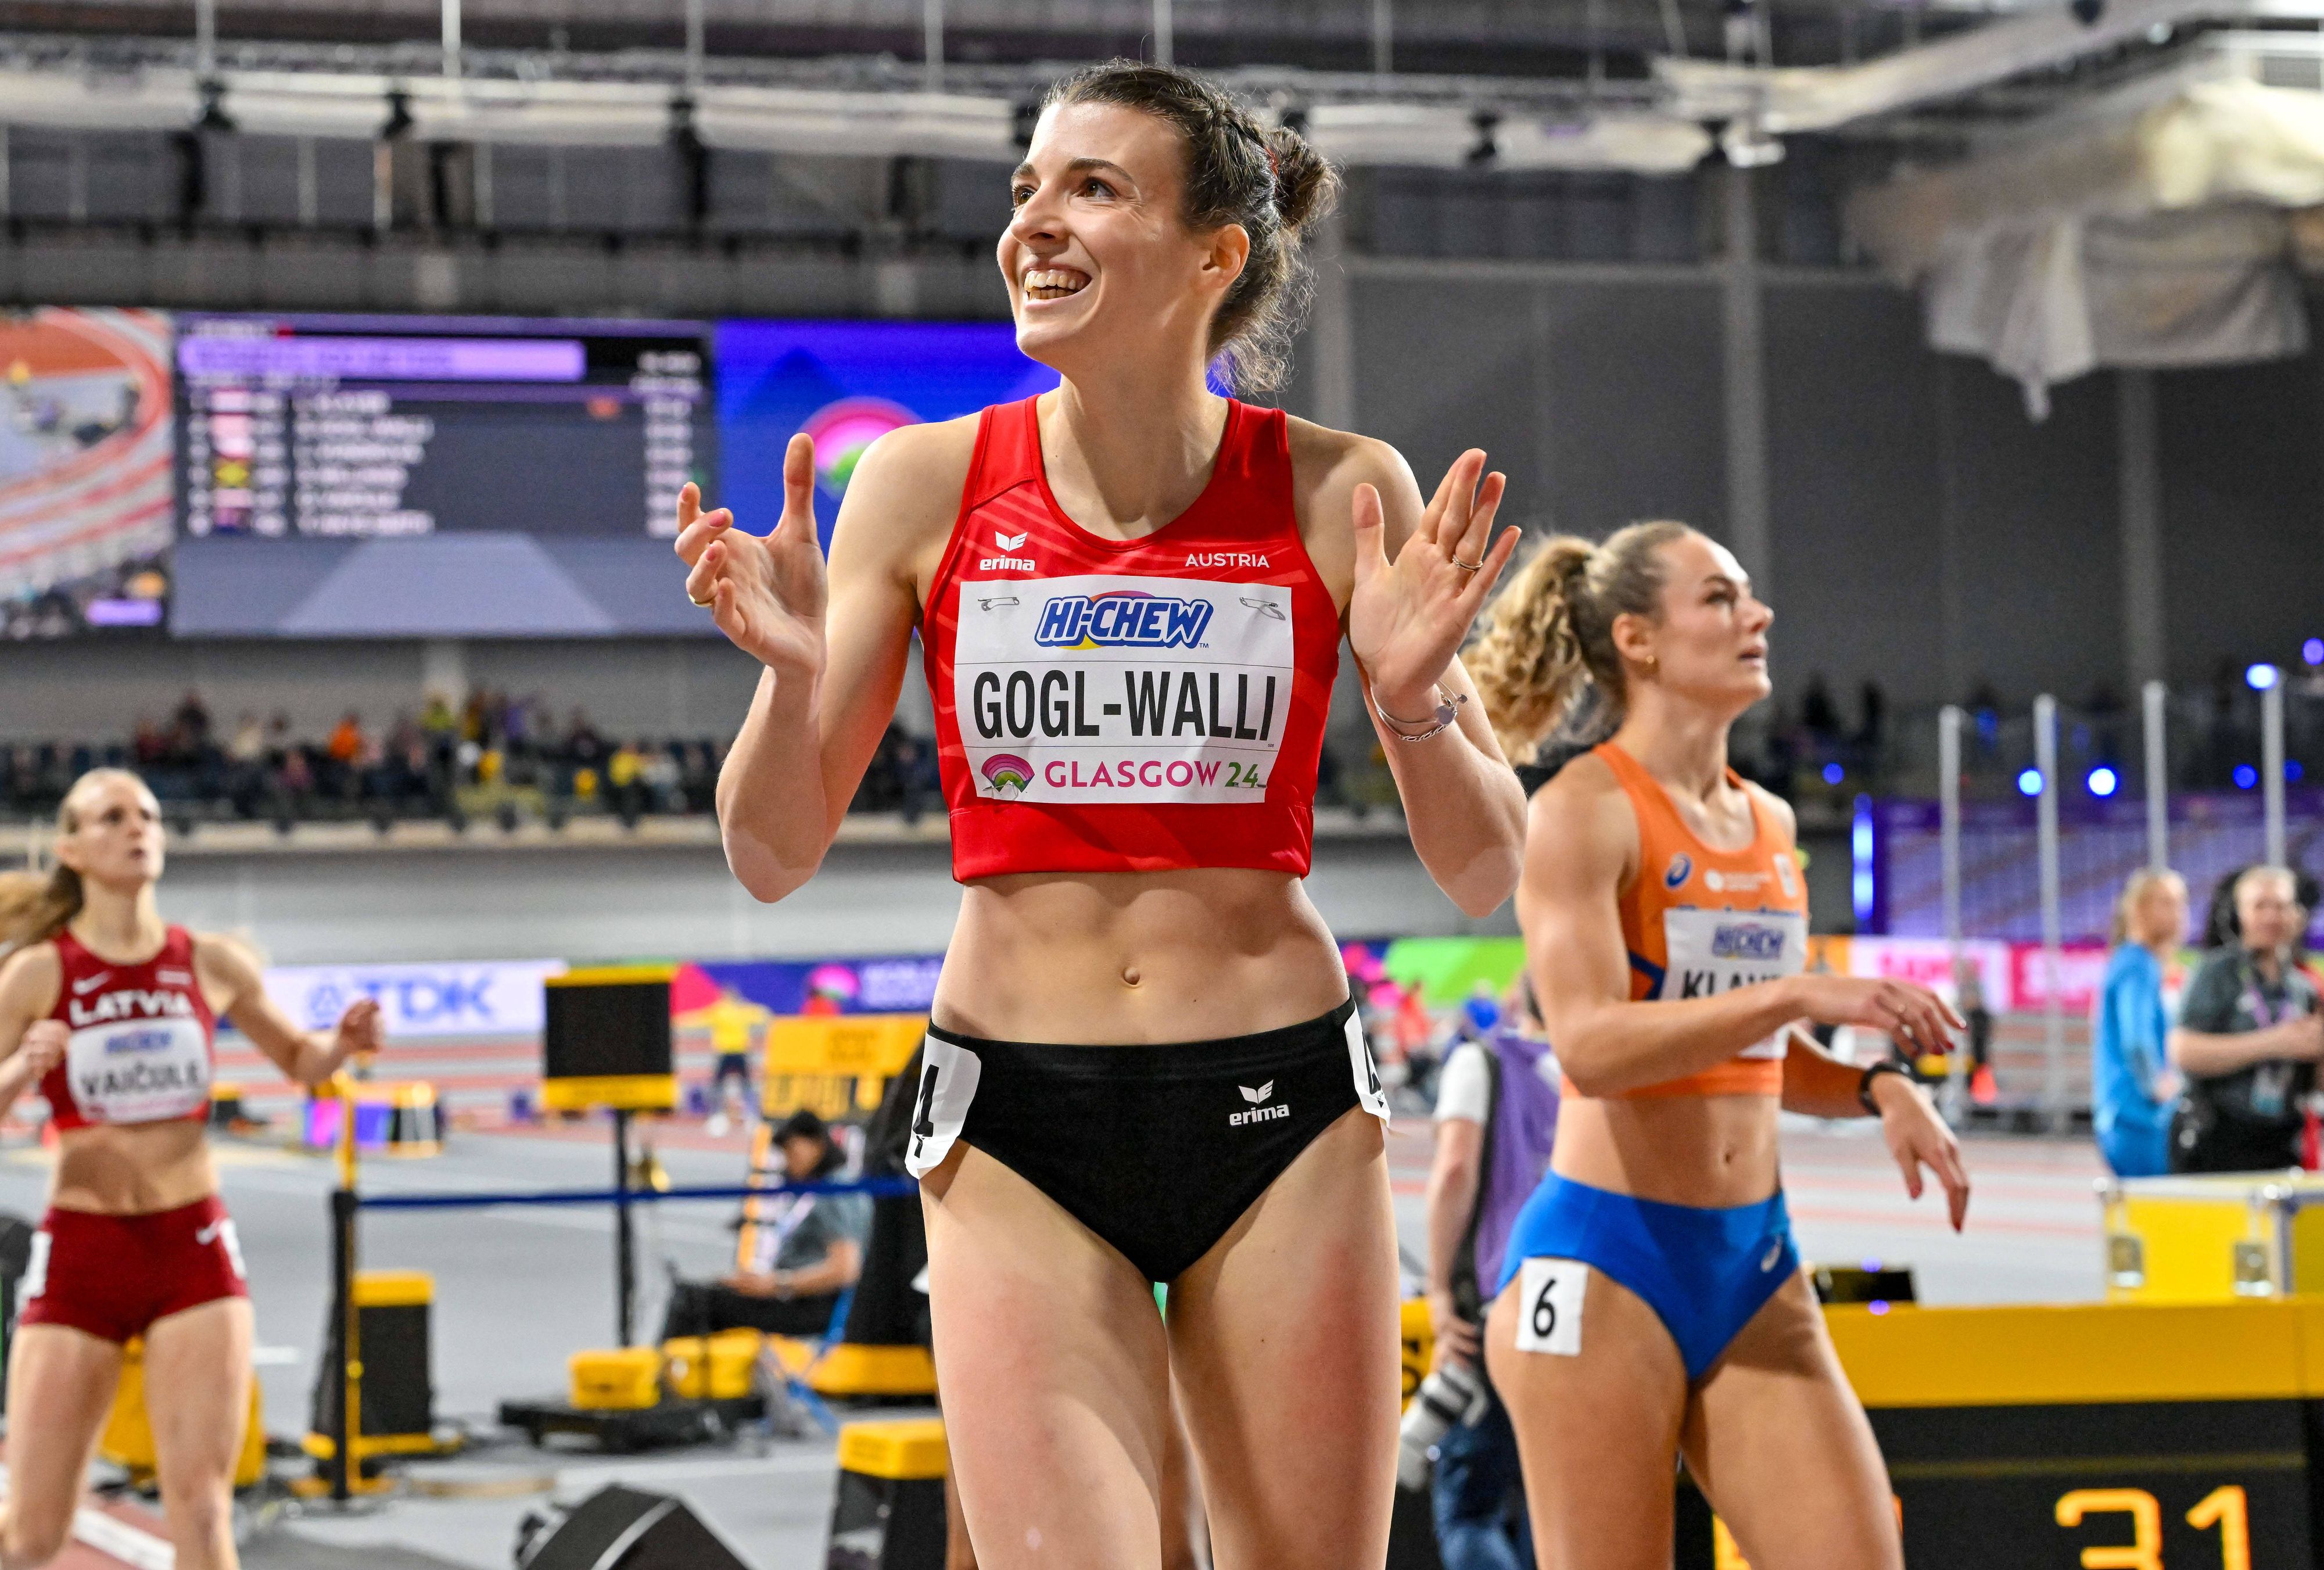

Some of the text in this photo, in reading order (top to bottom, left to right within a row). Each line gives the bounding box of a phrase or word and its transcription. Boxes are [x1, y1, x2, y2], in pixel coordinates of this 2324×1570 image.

[980, 555, 1035, 571] erima
[1185, 553, 1270, 568] AUSTRIA
[1035, 596, 1214, 649] HI-CHEW
[973, 669, 1276, 741] GOGL-WALLI
[1045, 760, 1258, 788] GLASGOW 24
[70, 990, 194, 1027] LATVIA
[1229, 1104, 1290, 1126] erima
[1533, 1278, 1556, 1338] 6
